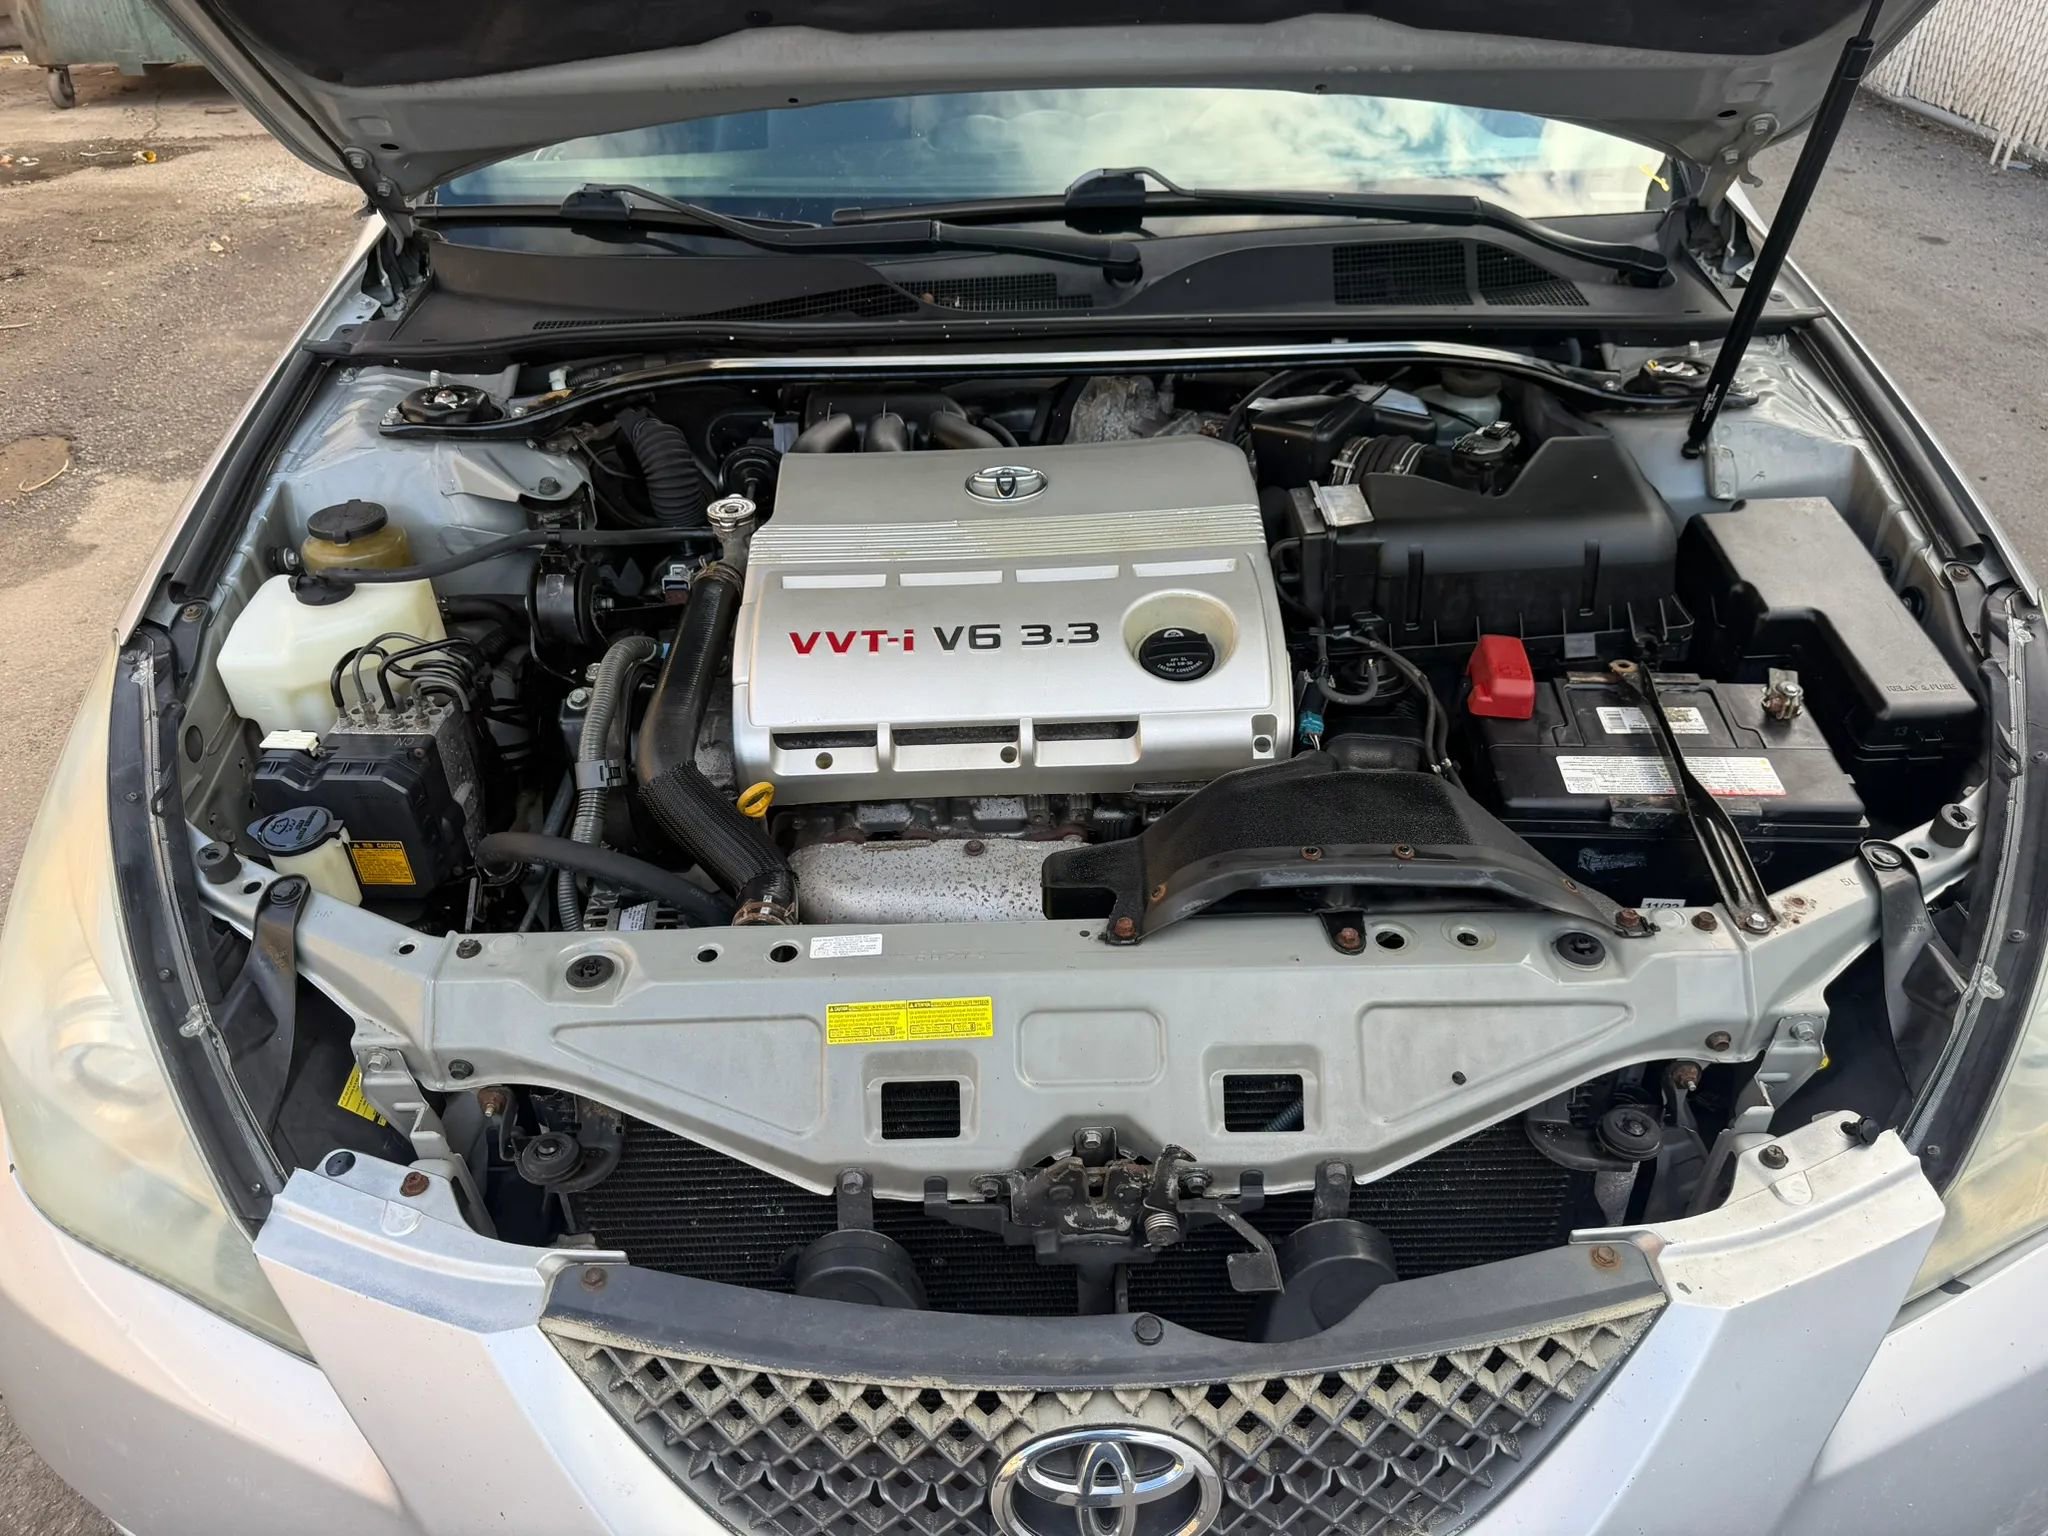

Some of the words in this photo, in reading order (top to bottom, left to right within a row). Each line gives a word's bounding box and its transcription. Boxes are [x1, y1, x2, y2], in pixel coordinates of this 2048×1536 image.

[789, 629, 914, 655] VVT-i
[933, 624, 1001, 652] V6
[1021, 622, 1099, 648] 3.3
